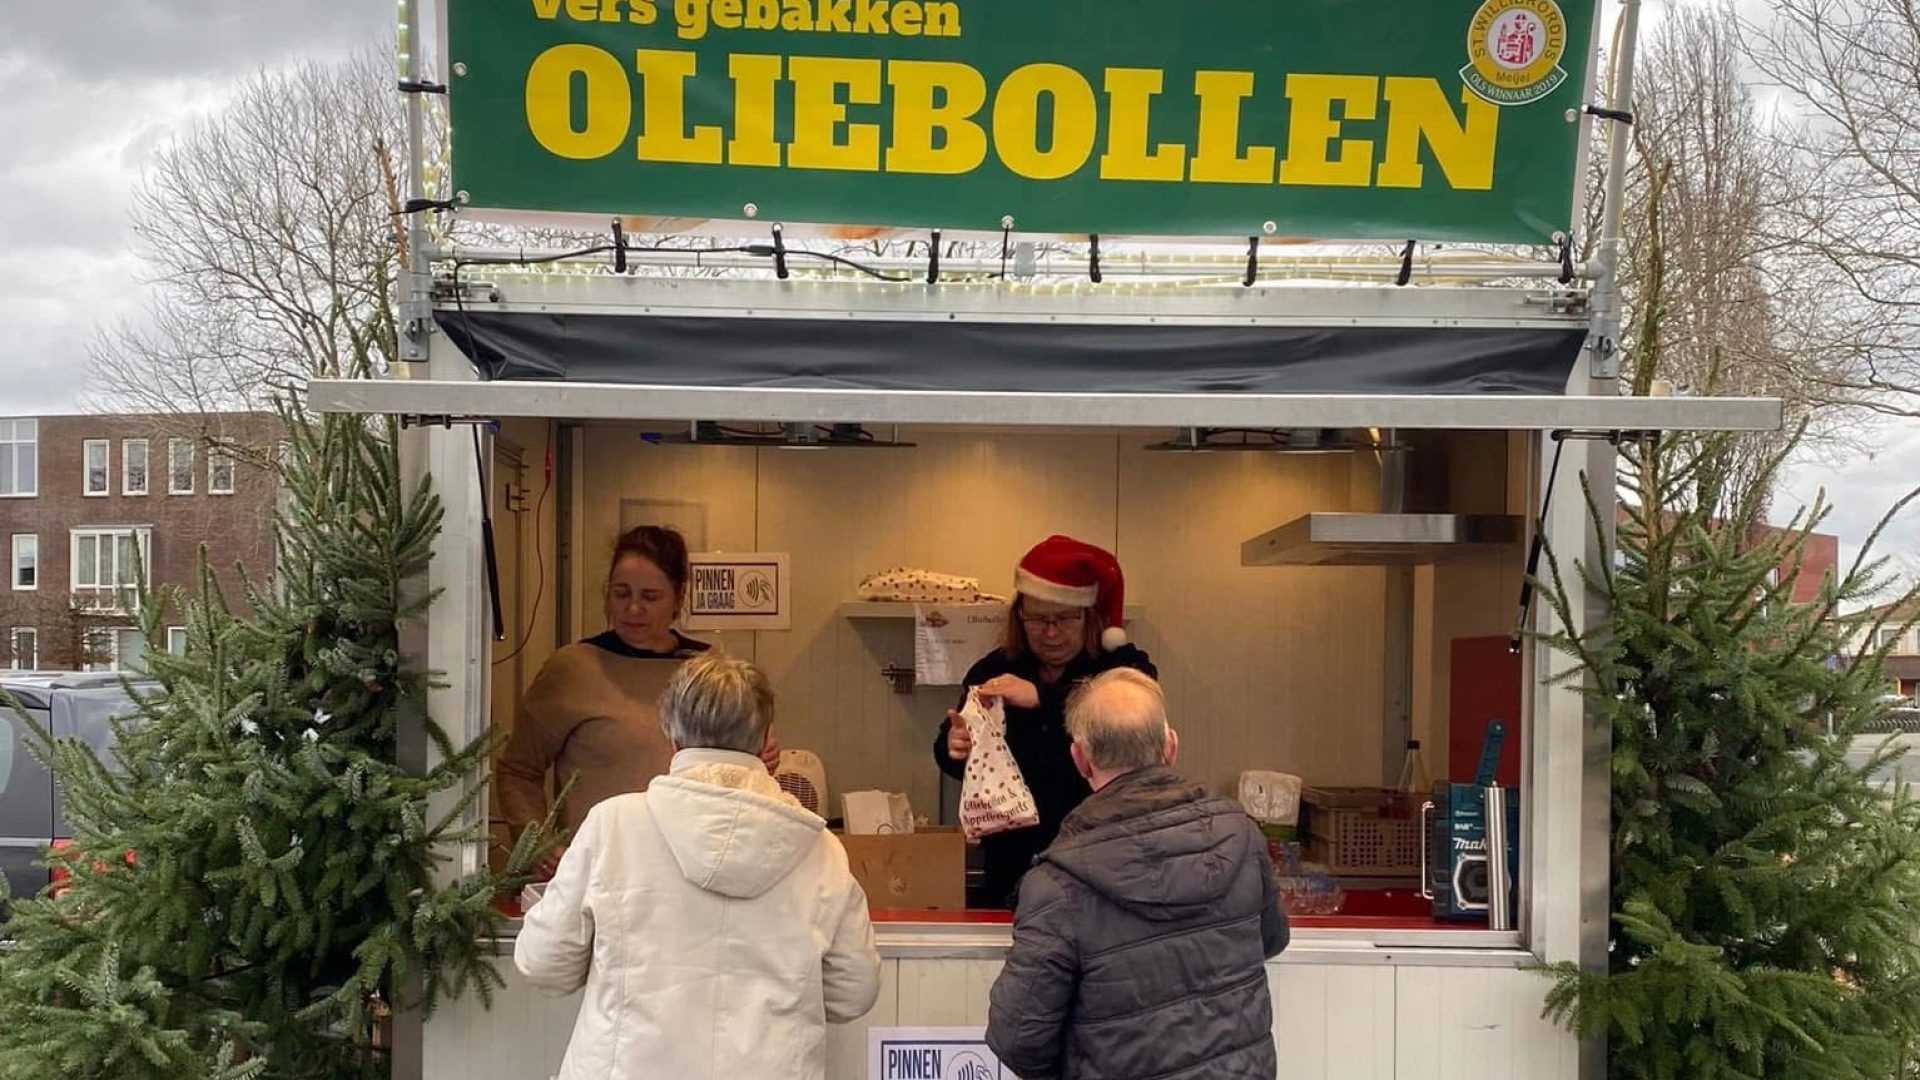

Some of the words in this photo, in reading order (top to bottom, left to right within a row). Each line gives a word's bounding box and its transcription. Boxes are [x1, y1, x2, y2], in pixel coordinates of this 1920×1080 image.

[675, 0, 961, 39] gebakken
[1487, 86, 1533, 101] WINNAAR
[1533, 74, 1559, 94] 2019
[525, 43, 1500, 191] OLIEBOLLEN
[695, 568, 735, 591] PINNEN
[696, 592, 706, 609] JA
[707, 592, 735, 609] GRAAG
[888, 1049, 942, 1080] PINNEN
